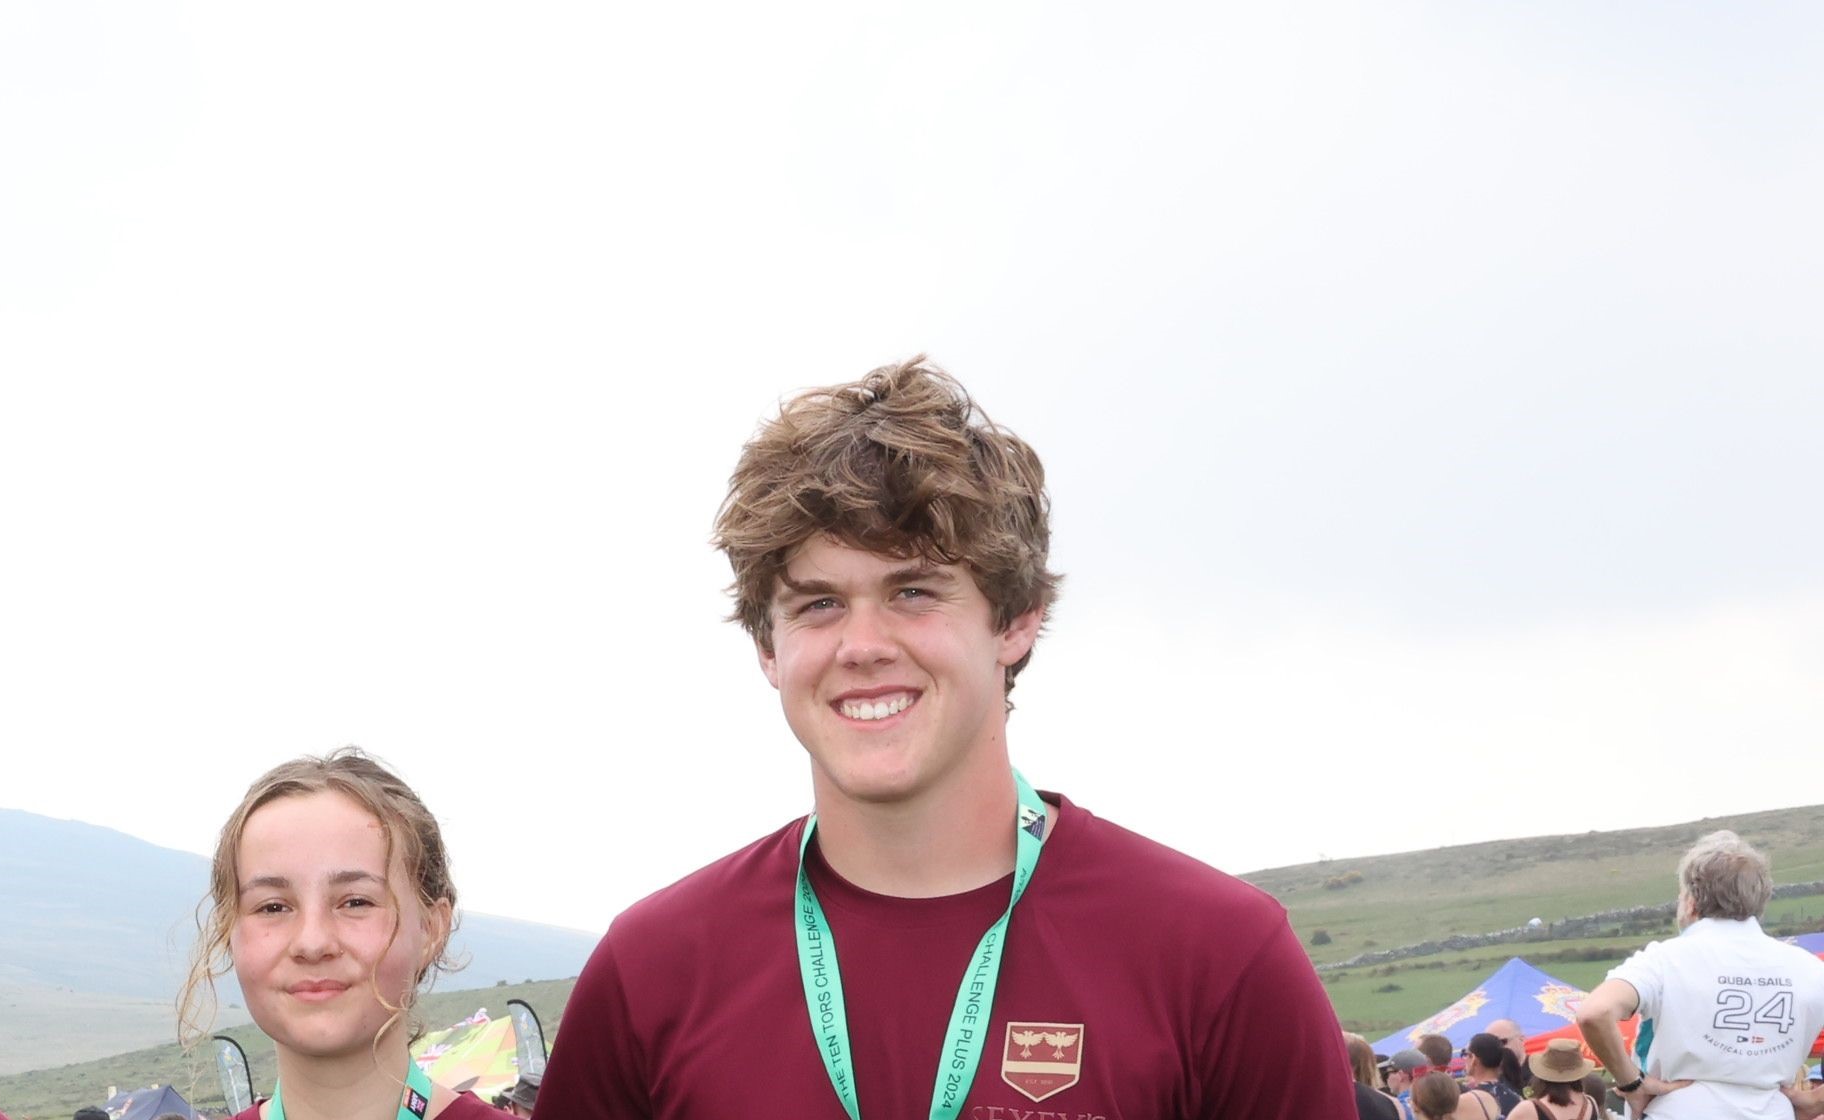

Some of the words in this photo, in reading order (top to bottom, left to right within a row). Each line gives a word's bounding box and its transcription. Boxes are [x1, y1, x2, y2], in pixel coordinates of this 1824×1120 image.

[803, 904, 828, 987] CHALLENGE
[961, 933, 997, 1024] CHALLENGE
[819, 991, 834, 1033] TORS
[1713, 989, 1795, 1033] 24
[828, 1035, 840, 1069] TEN
[951, 1028, 974, 1070] PLUS
[1703, 1034, 1743, 1055] NAUTICAL
[834, 1069, 850, 1099] THE
[942, 1073, 962, 1109] 2024
